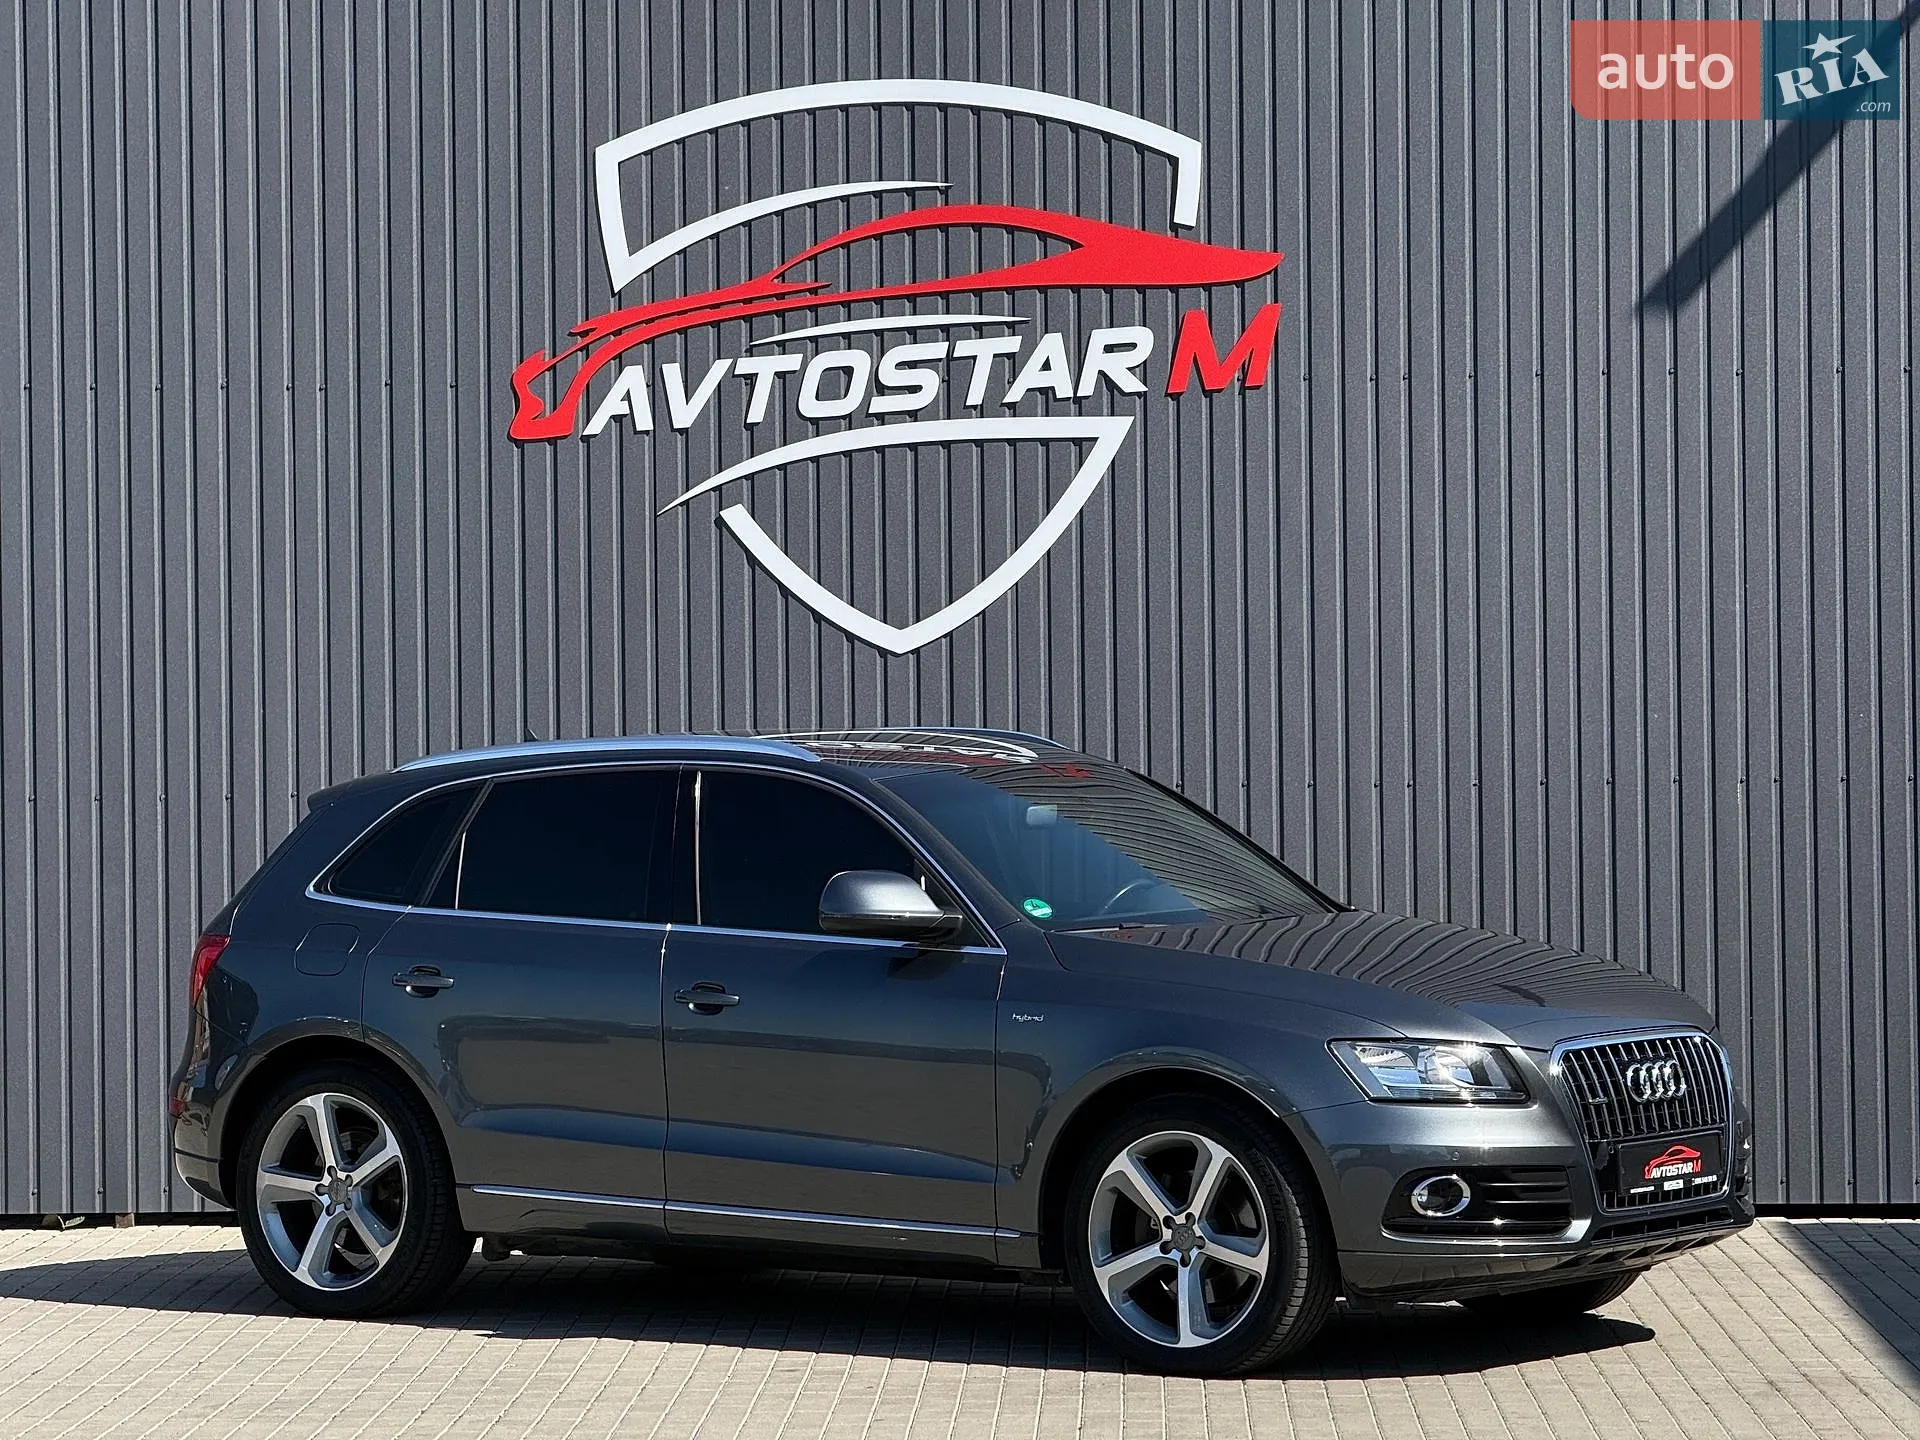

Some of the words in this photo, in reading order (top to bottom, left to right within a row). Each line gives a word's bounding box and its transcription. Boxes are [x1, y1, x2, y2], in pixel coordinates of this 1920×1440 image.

[583, 326, 1154, 436] AVTOSTAR
[1169, 303, 1282, 392] M
[1651, 1161, 1693, 1178] AVTOSTAR
